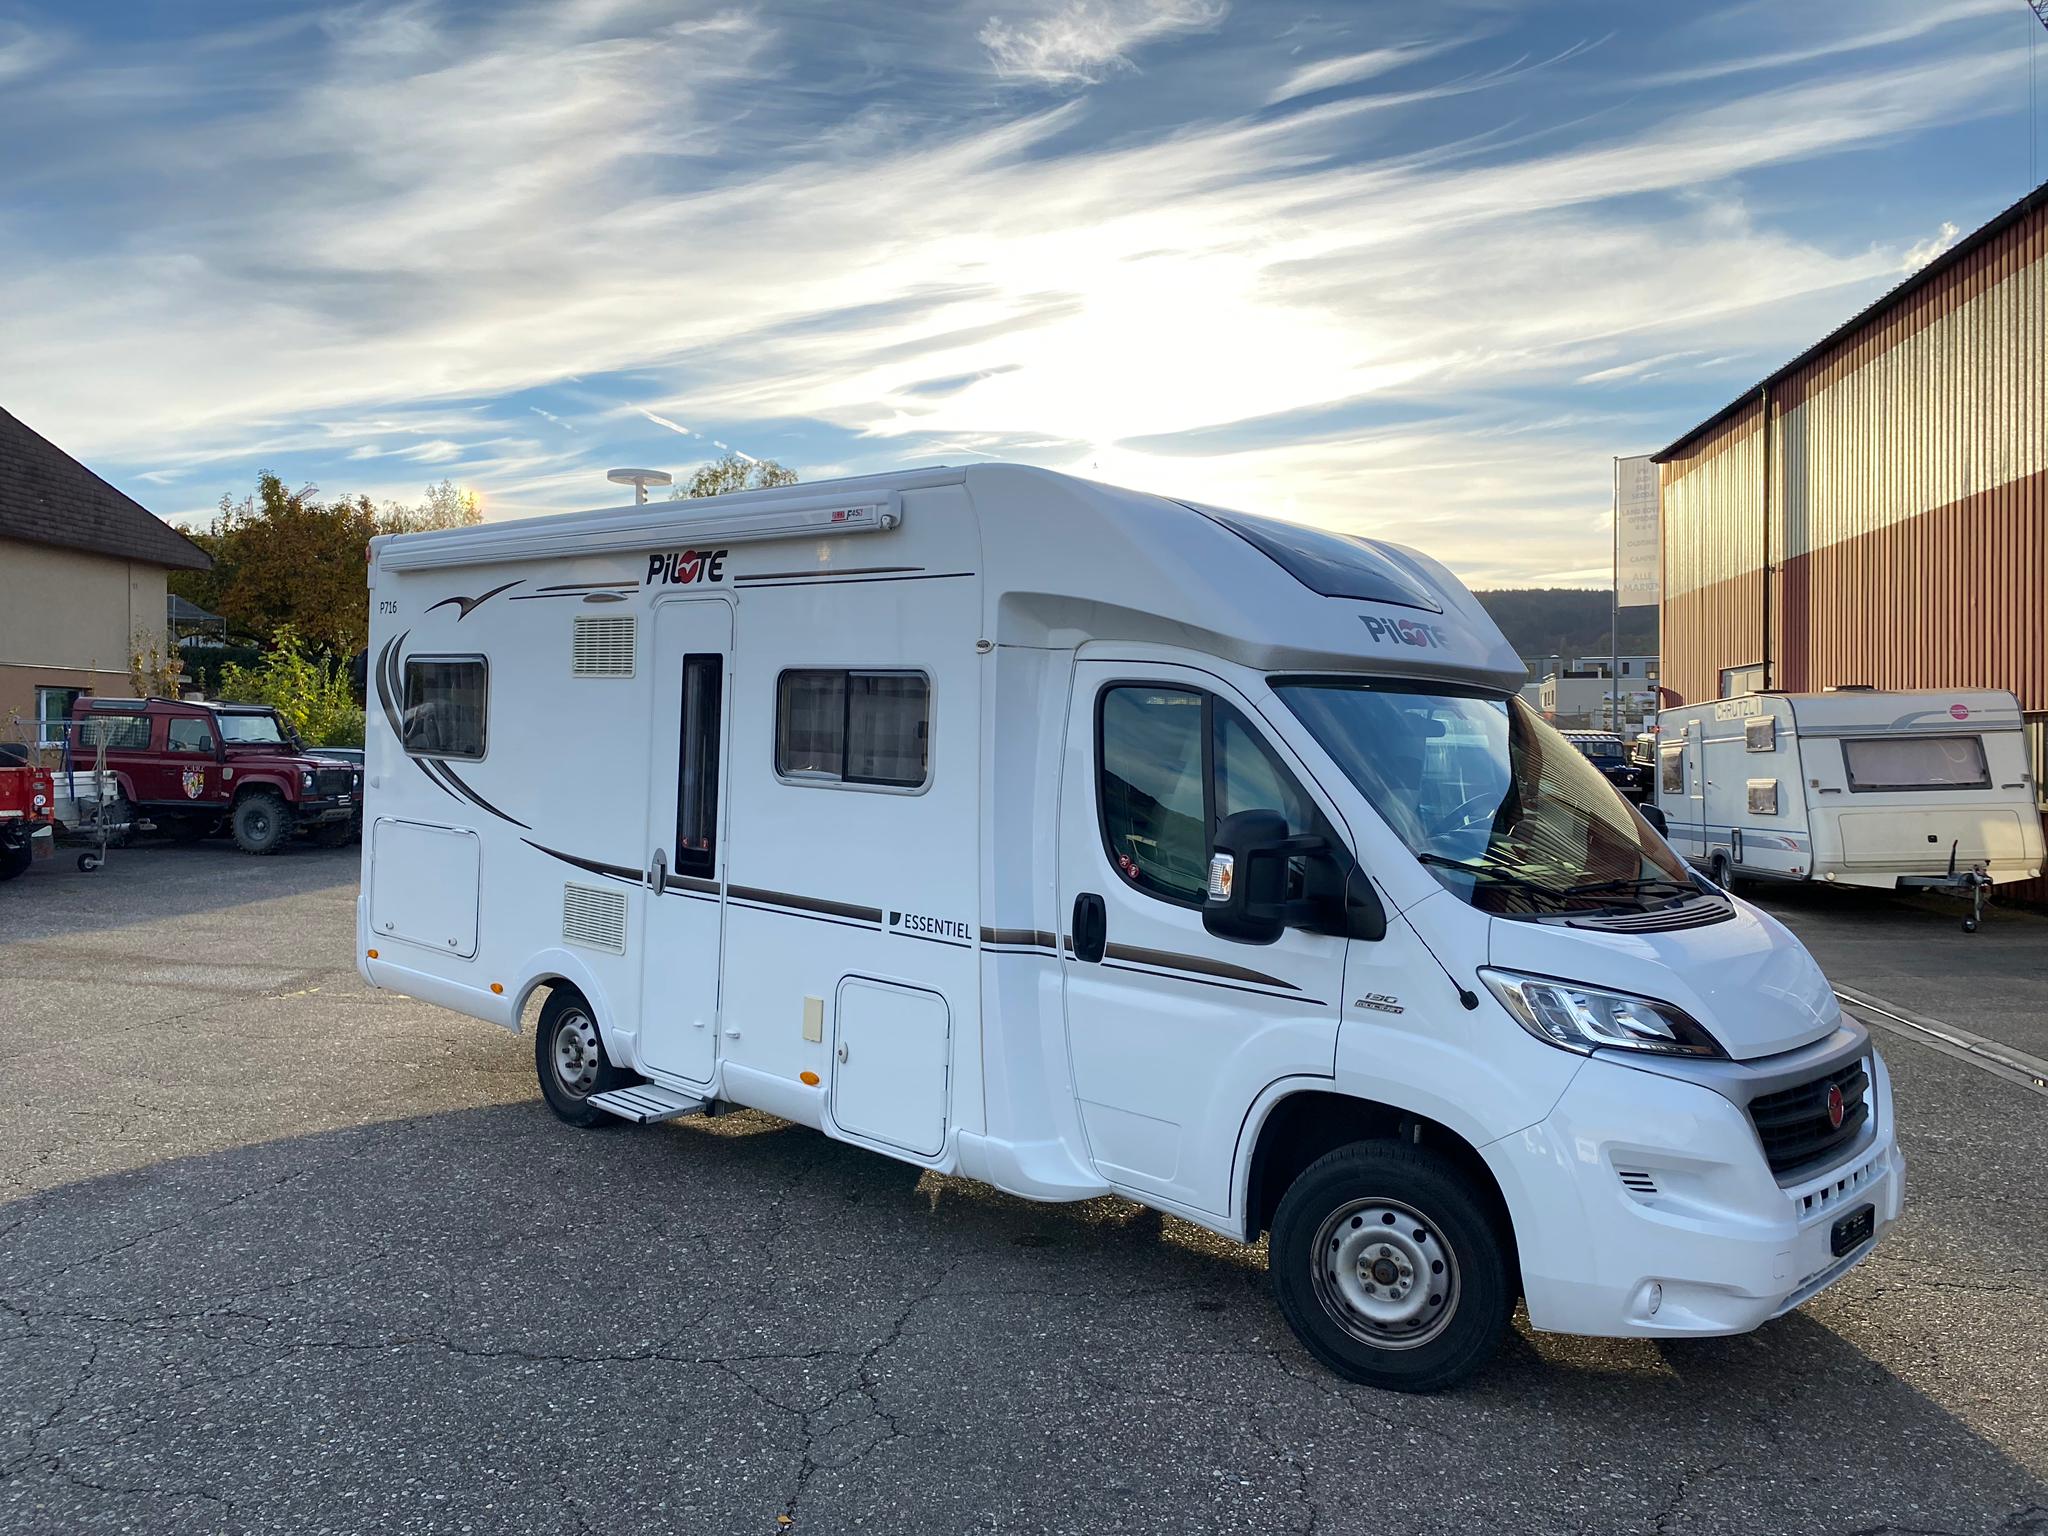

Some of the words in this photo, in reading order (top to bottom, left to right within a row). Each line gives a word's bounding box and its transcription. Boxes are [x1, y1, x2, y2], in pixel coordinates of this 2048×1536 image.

[1632, 571, 1652, 581] ALLE
[380, 601, 398, 614] P716
[904, 913, 972, 940] ESSENTIEL
